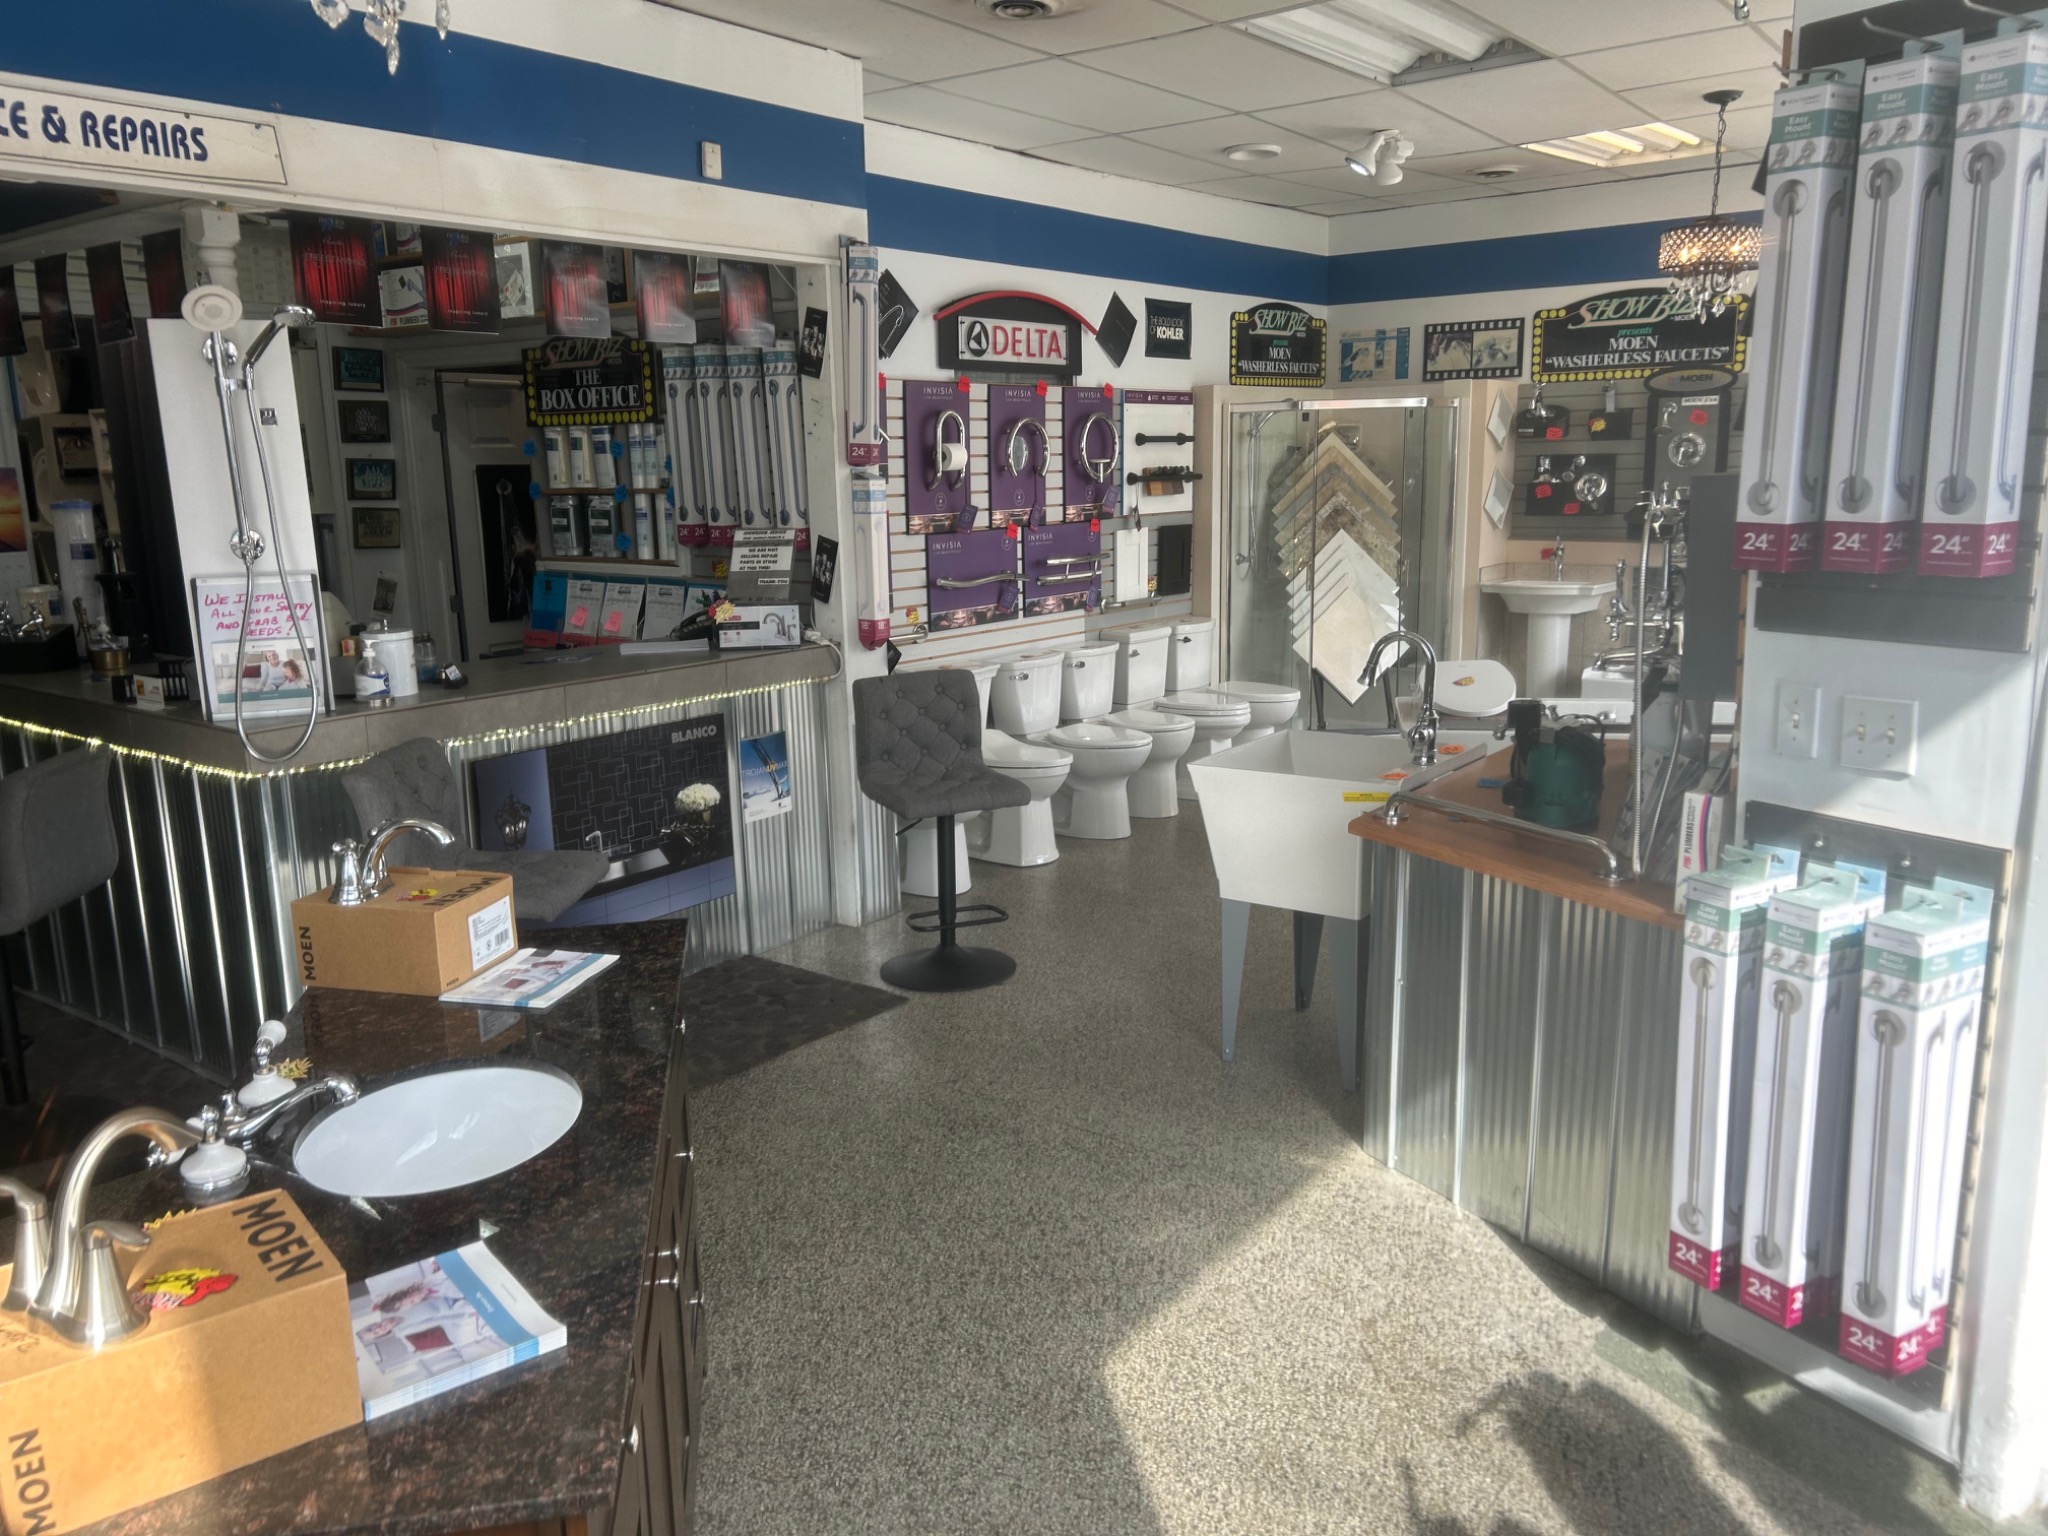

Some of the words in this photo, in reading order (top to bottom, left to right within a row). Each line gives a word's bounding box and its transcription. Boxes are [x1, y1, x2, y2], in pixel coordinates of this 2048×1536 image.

[1979, 71, 2006, 83] Easy
[1975, 79, 2008, 91] Mount
[1881, 91, 1904, 103] Easy
[1877, 100, 1906, 111] Mount
[1789, 115, 1808, 125] Easy
[41, 105, 70, 144] &
[80, 110, 209, 162] REPAIRS
[1784, 123, 1812, 133] Mount
[319, 299, 346, 308] inspiring
[1567, 295, 1651, 329] SHOW
[1149, 315, 1158, 325] THE
[1159, 316, 1171, 327] BOLD
[1171, 317, 1184, 327] LOOK
[1249, 309, 1289, 335] SHOW
[1286, 311, 1310, 336] BIZ
[1150, 325, 1156, 335] OF
[1156, 326, 1184, 341] KOHLER
[1617, 325, 1653, 337] presents
[991, 324, 1063, 359] DELTA
[1608, 335, 1658, 351] MOEN
[540, 337, 593, 370] SHOW
[1268, 347, 1292, 360] MOEN
[573, 368, 602, 386] THE
[1679, 373, 1714, 382] MOEN
[540, 388, 576, 411] BOX
[577, 384, 640, 409] OFFICE
[923, 386, 953, 396] INVISIA
[1005, 389, 1032, 398] INVISIA
[1077, 390, 1101, 399] INVISIA
[1028, 532, 1054, 541] INVISIA
[1743, 531, 1775, 551] 24"
[1832, 531, 1868, 551] 24"
[1930, 533, 1970, 555] 24"
[1986, 533, 2011, 555] 24"
[932, 540, 962, 550] INVISIA
[204, 593, 230, 606] WE
[232, 592, 287, 604] ISTALL
[211, 608, 236, 618] ALL
[216, 621, 240, 630] AND
[671, 724, 717, 744] BLANCO
[1684, 822, 1695, 854] PLUMBERS
[423, 877, 502, 906] MOEN
[1696, 910, 1719, 921] Mount
[1700, 903, 1717, 915] Easy
[298, 926, 316, 981] MOEN
[232, 1198, 325, 1284] MOEN
[1675, 1242, 1703, 1266] 24"
[1747, 1277, 1778, 1302] 24"
[1849, 1327, 1883, 1353] 24"
[9, 1427, 57, 1536] MOEN
